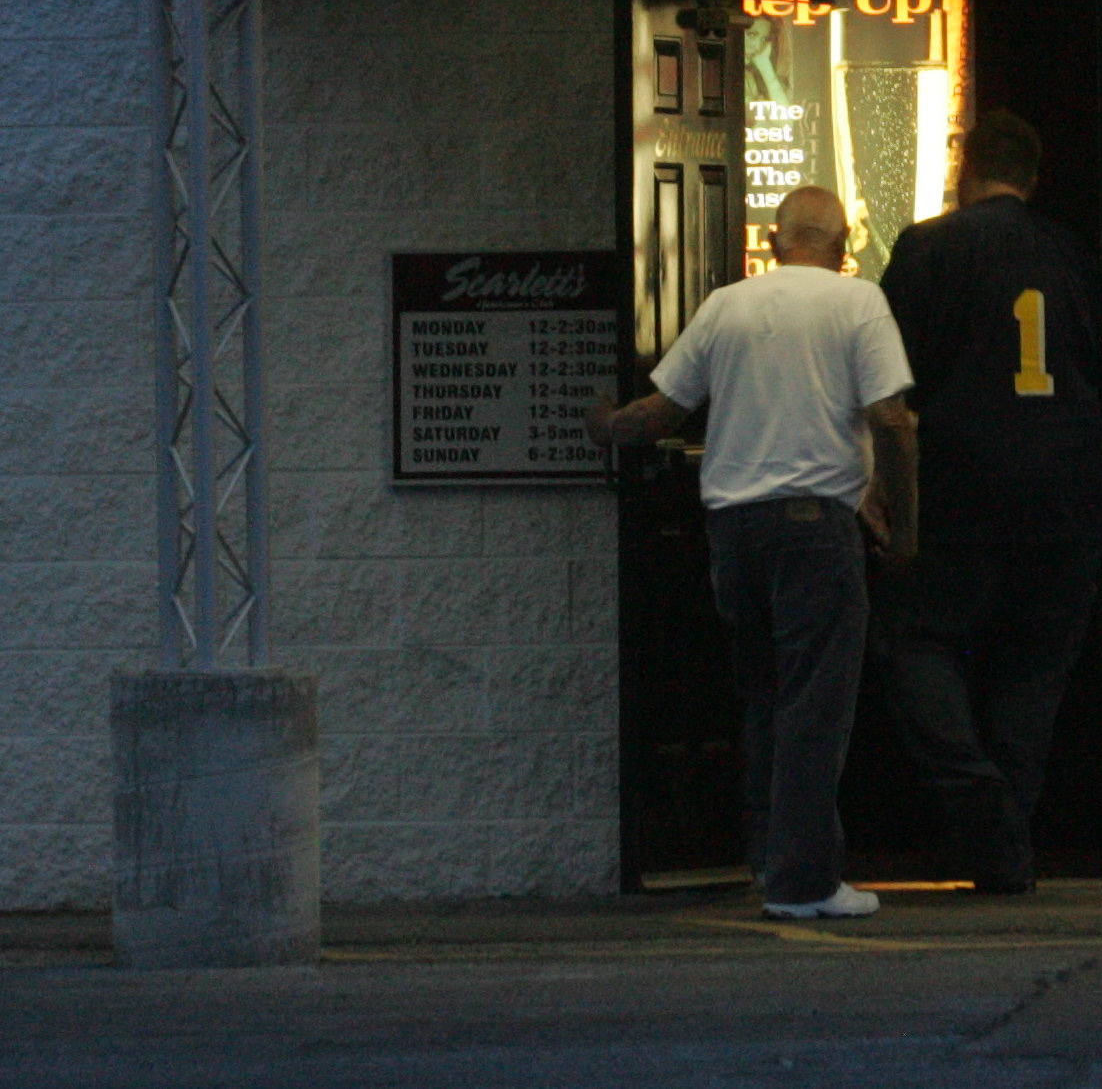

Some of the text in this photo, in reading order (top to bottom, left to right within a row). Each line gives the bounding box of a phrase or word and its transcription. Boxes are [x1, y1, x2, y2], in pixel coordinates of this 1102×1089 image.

[749, 101, 804, 121] The
[746, 166, 801, 186] The
[412, 321, 486, 335] MONDAY
[412, 341, 488, 357] TUESDAY
[1013, 288, 1055, 396] 1
[412, 362, 518, 378] WEDNESDAY
[412, 383, 595, 399] THURSDAY 12-4am
[412, 405, 474, 421] FRIDAY
[412, 425, 584, 442] SATURDAY 3-5am
[412, 447, 481, 463] SUNDAY
